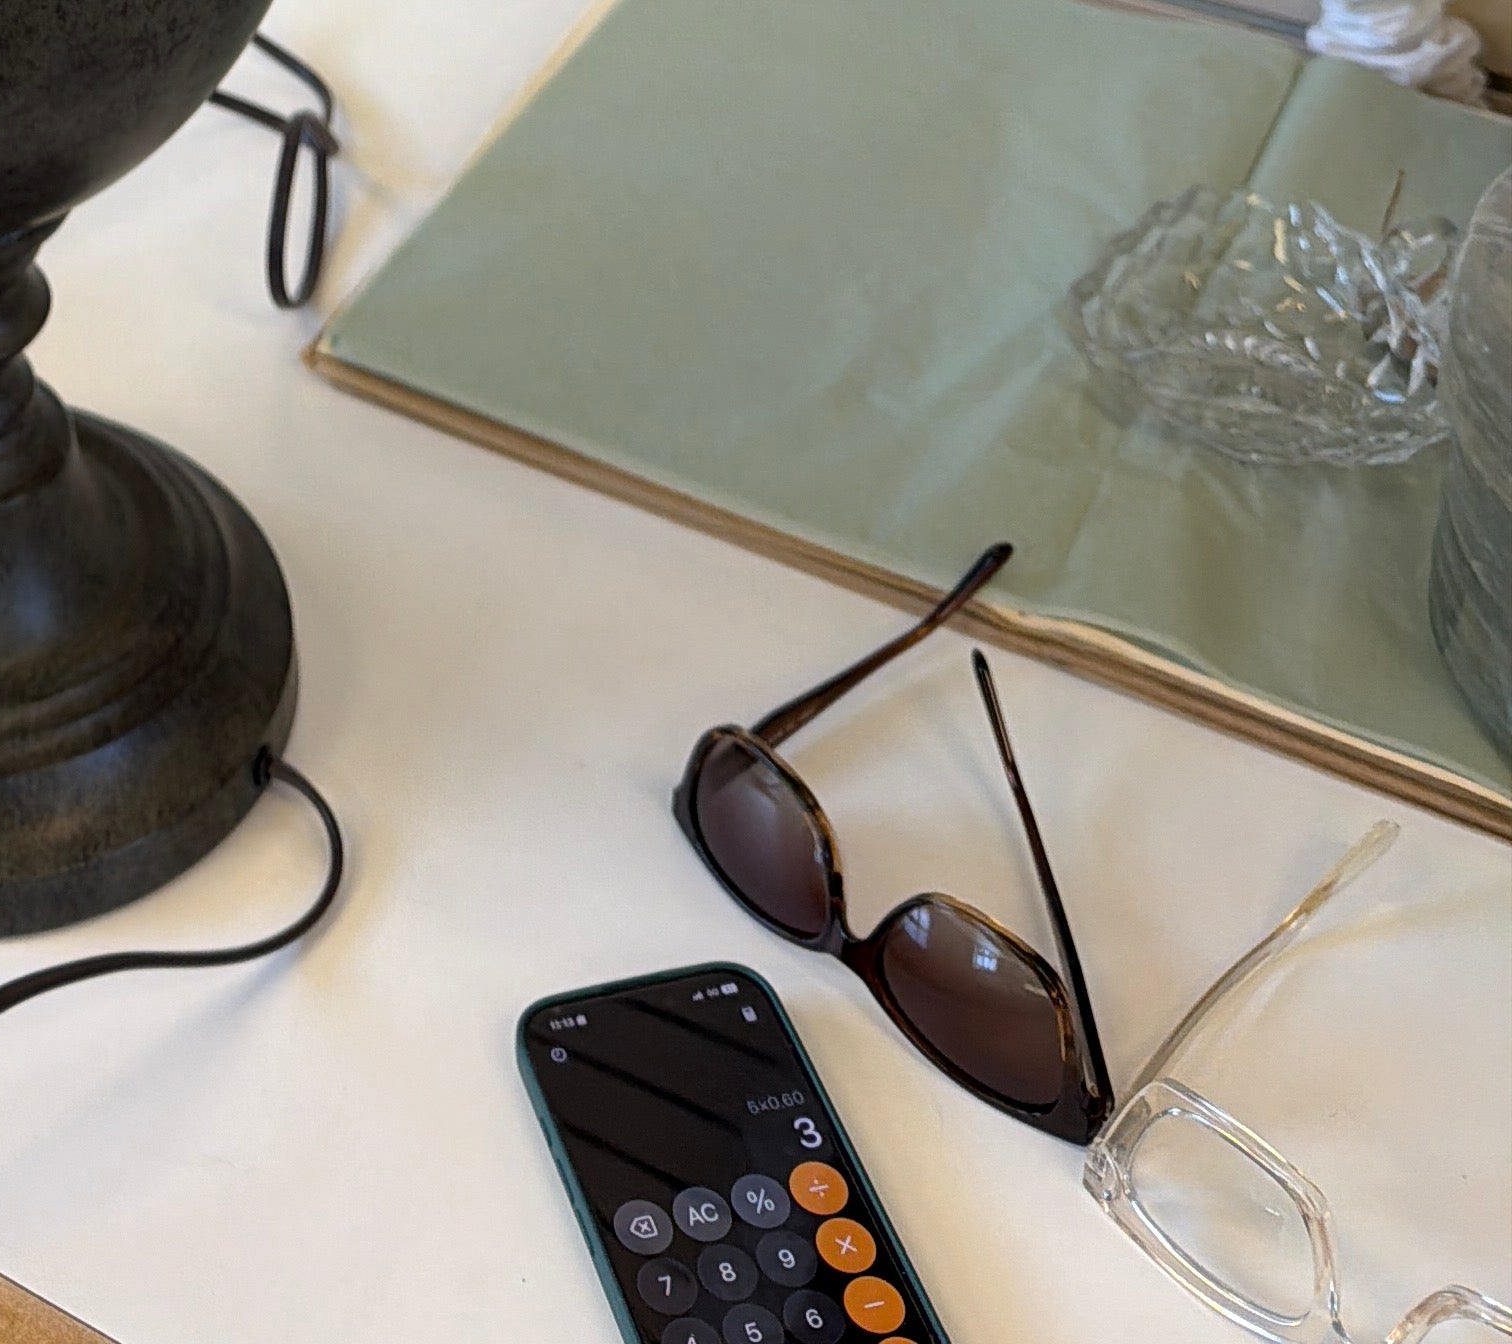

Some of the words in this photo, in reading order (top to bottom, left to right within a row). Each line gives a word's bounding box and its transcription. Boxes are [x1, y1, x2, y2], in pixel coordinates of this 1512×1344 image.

[793, 1117, 823, 1149] 3
[688, 1202, 719, 1226] AC
[746, 1188, 775, 1214] %
[658, 1275, 671, 1297] 7
[718, 1262, 737, 1282] 8
[778, 1249, 796, 1269] 9
[744, 1321, 763, 1343] 5
[805, 1308, 824, 1330] 6
